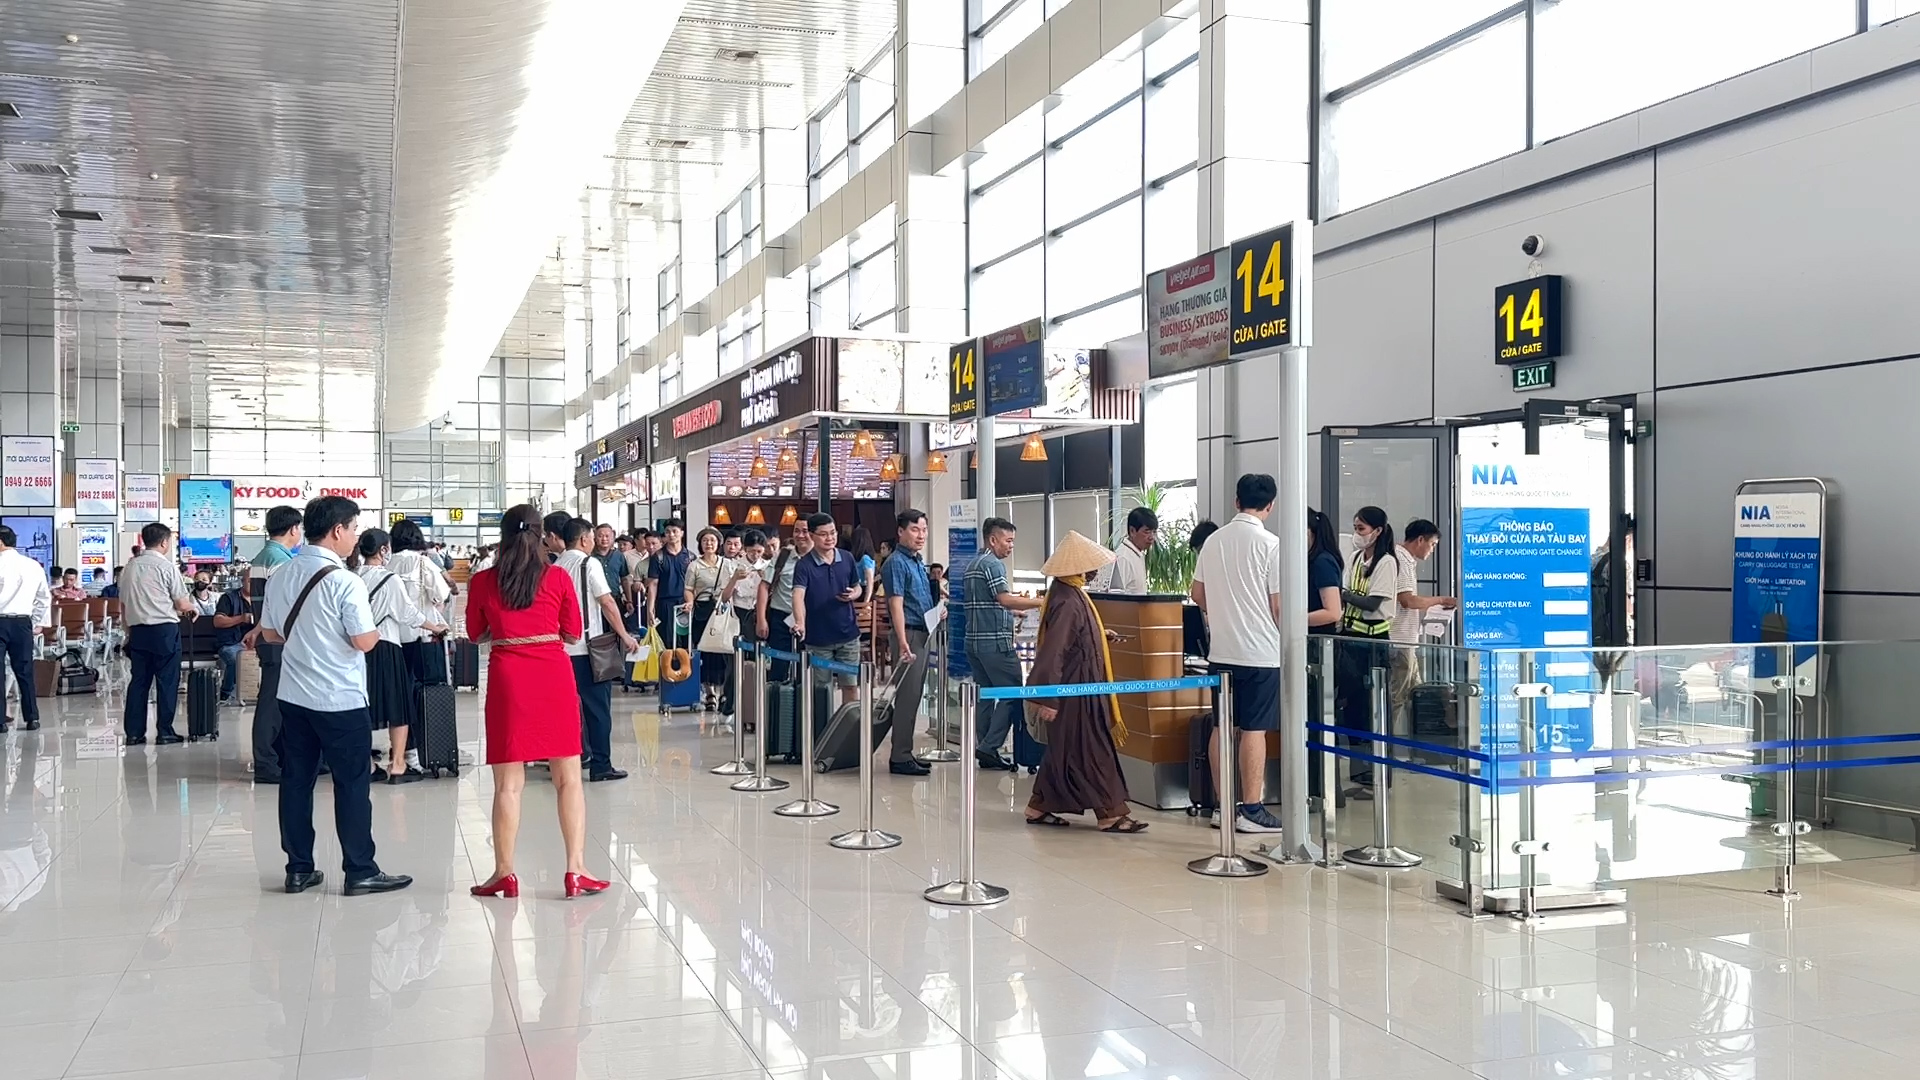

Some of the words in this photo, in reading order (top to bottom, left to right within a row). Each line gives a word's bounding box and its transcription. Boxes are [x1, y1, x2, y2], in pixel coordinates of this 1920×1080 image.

[1236, 240, 1285, 314] 14
[1214, 287, 1227, 302] GIA
[1499, 288, 1544, 342] 14
[1160, 308, 1229, 339] BUSINESS/SKYBOSS
[1234, 325, 1254, 344] CỬA
[1261, 318, 1287, 338] GATE
[1522, 342, 1542, 355] GATE
[952, 348, 975, 395] 14
[1517, 366, 1547, 386] EXIT
[5, 476, 21, 487] 0949
[24, 476, 33, 487] 22
[1472, 464, 1518, 485] NIA
[93, 491, 100, 499] 22
[234, 487, 254, 498] KY
[256, 487, 300, 498] FOOD
[320, 488, 367, 499] DRINK
[451, 509, 462, 518] 16
[950, 505, 963, 517] NIA
[1741, 505, 1771, 520] NIA
[1498, 520, 1531, 532] THÔNG
[1533, 520, 1554, 532] BÁO
[1466, 534, 1489, 543] THAY
[1533, 534, 1546, 543] RA
[1548, 532, 1566, 543] TÀU
[1568, 534, 1587, 544] BAY
[1470, 548, 1494, 556] NOTICE
[1495, 548, 1504, 556] OF
[1505, 548, 1538, 556] BOARDING
[1539, 548, 1555, 556] GATE
[1556, 548, 1583, 556] CHANGE
[1807, 552, 1817, 560] TAY
[1540, 724, 1563, 744] 15
